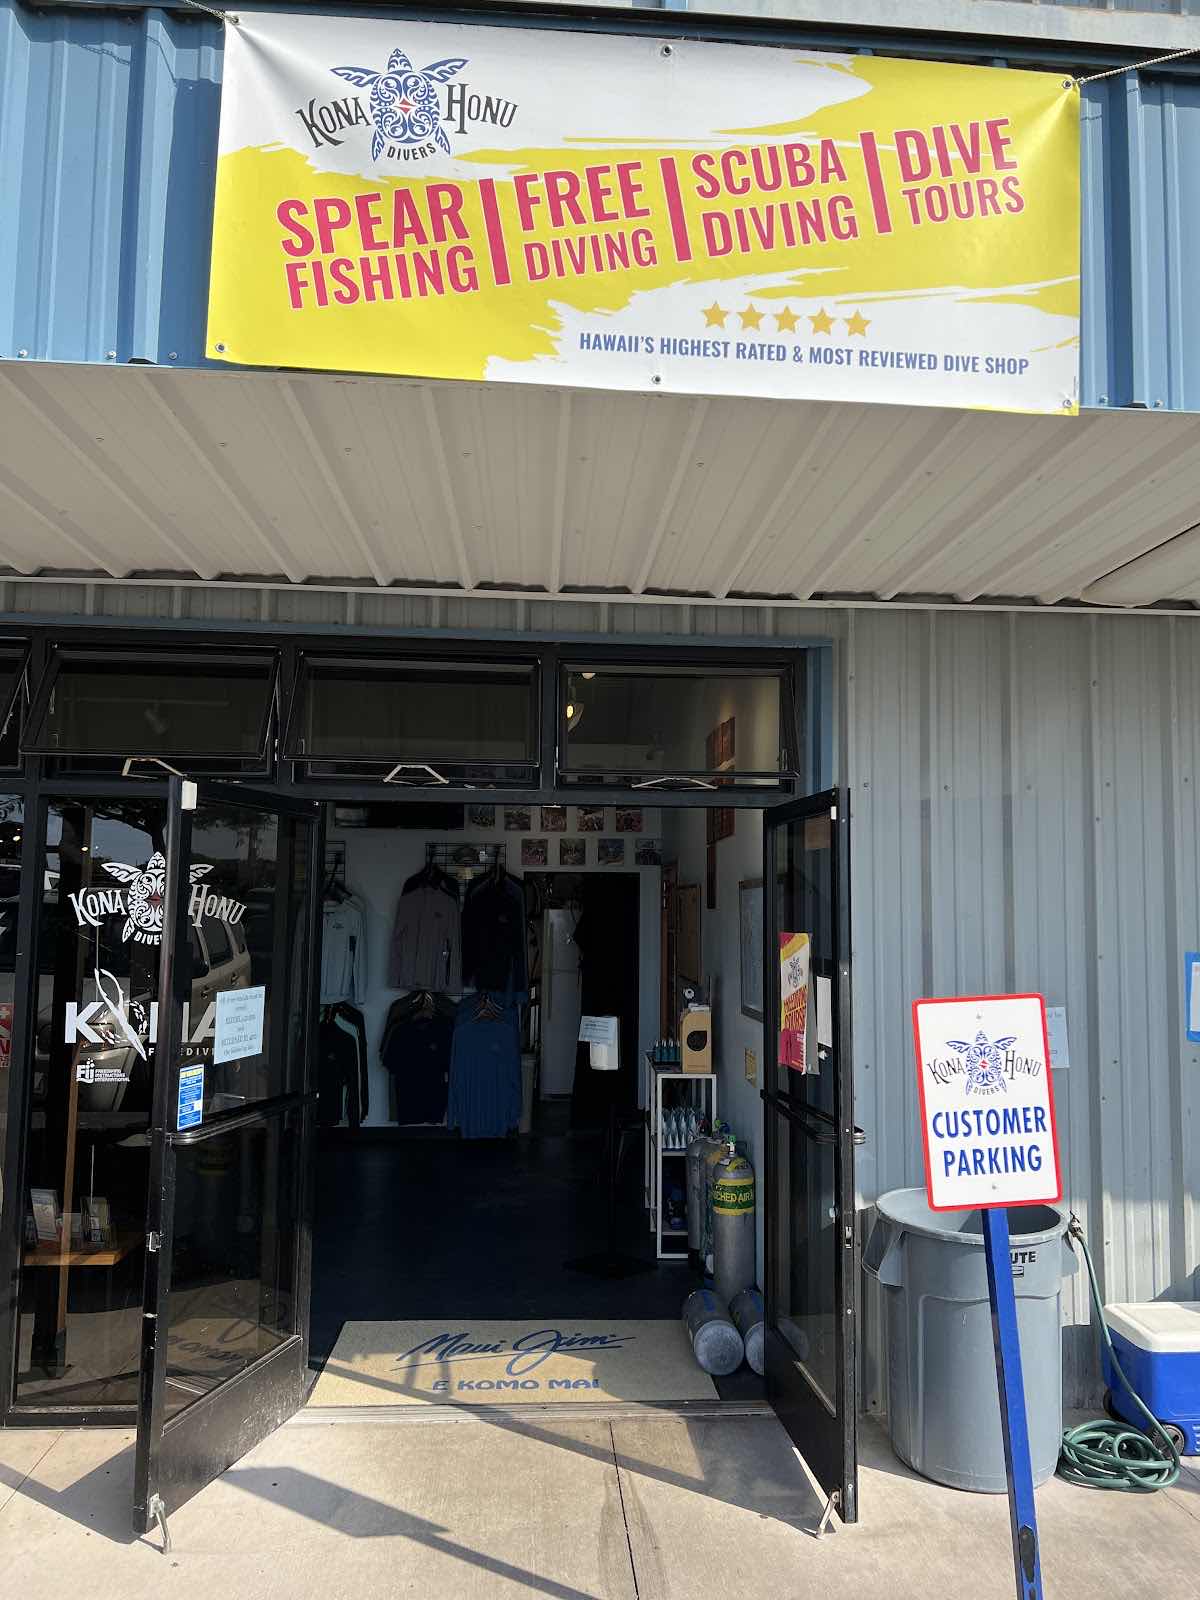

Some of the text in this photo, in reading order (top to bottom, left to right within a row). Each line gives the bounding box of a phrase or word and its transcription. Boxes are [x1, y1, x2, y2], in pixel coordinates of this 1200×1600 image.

[295, 83, 519, 148] KONA HONU
[386, 142, 437, 161] DIVERS
[691, 138, 848, 199] SCUBA
[893, 118, 1018, 184] DIVE
[276, 181, 471, 258] SPEAR
[513, 161, 651, 232] FREE
[901, 175, 1025, 226] TOURS
[701, 194, 859, 258] DIVING
[285, 245, 480, 310] FISHING
[523, 228, 658, 281] DIVING
[579, 332, 1030, 375] HAWAII'S HIGHEST RATED & MOST REVIEWED DIVE SHOP
[67, 883, 248, 928] KONA HONU
[133, 931, 163, 946] DIVE
[926, 1050, 1043, 1085] KONA HONU
[973, 1085, 1000, 1095] DIVERS
[932, 1106, 1047, 1139] CUSTOMER
[943, 1144, 1042, 1177] PARKING
[1010, 1251, 1036, 1264] UTE
[396, 1329, 630, 1376] Maui Jim
[432, 1378, 601, 1391] E KOMO MAI
